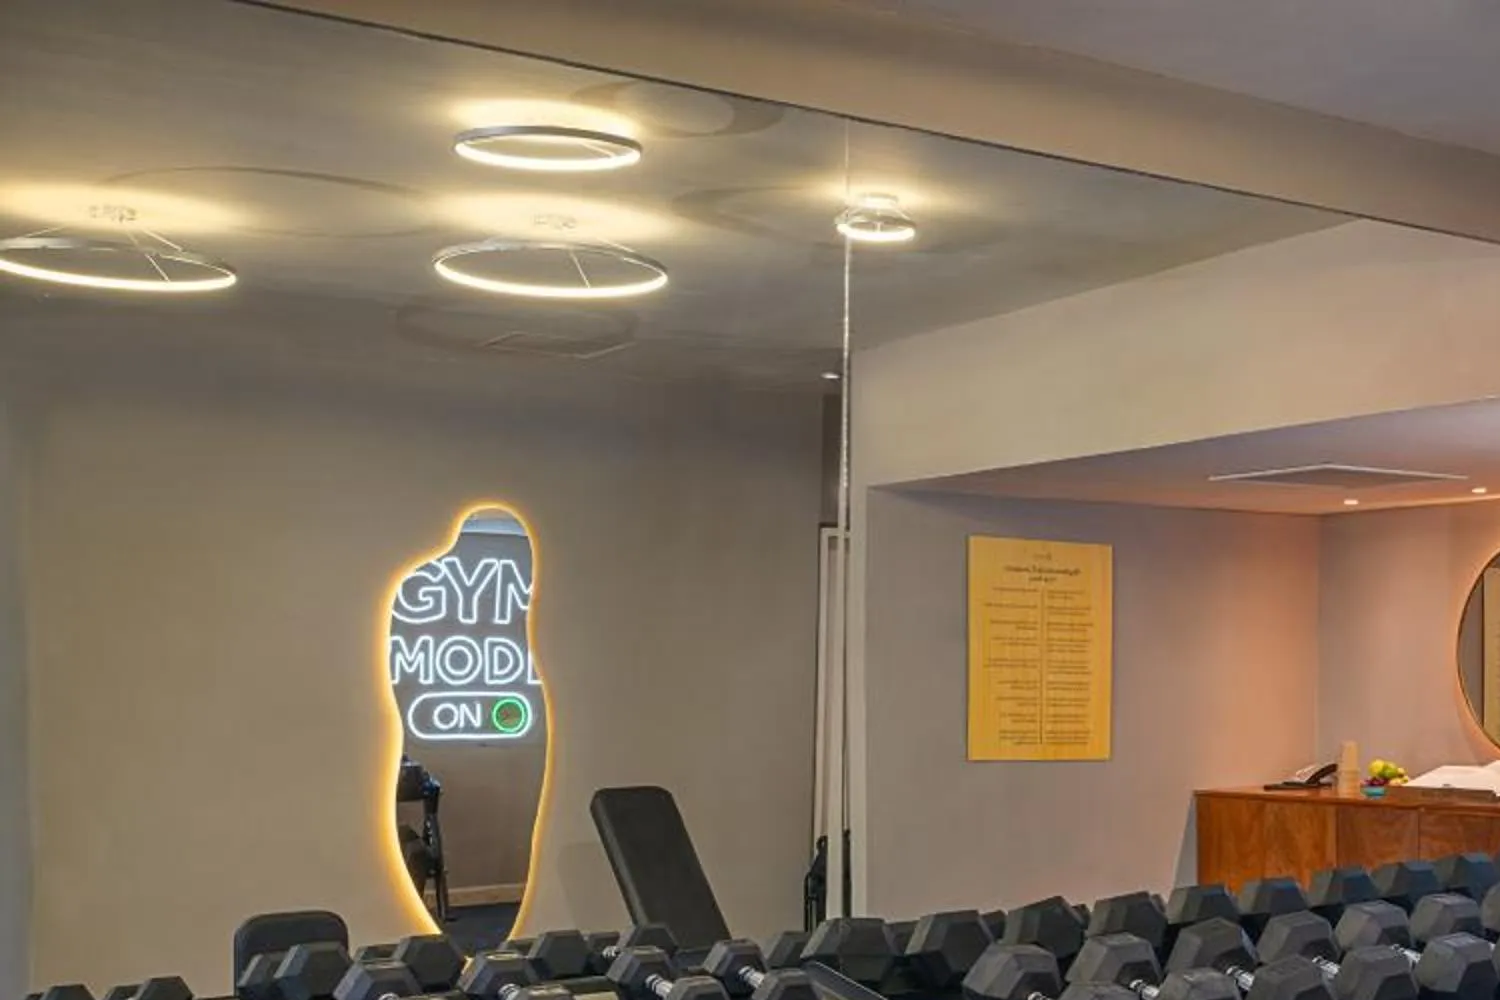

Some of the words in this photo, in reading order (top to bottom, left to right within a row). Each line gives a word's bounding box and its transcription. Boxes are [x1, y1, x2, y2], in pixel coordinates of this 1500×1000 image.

[391, 556, 533, 625] GYM
[390, 634, 544, 686] MOD
[432, 702, 482, 731] ON
